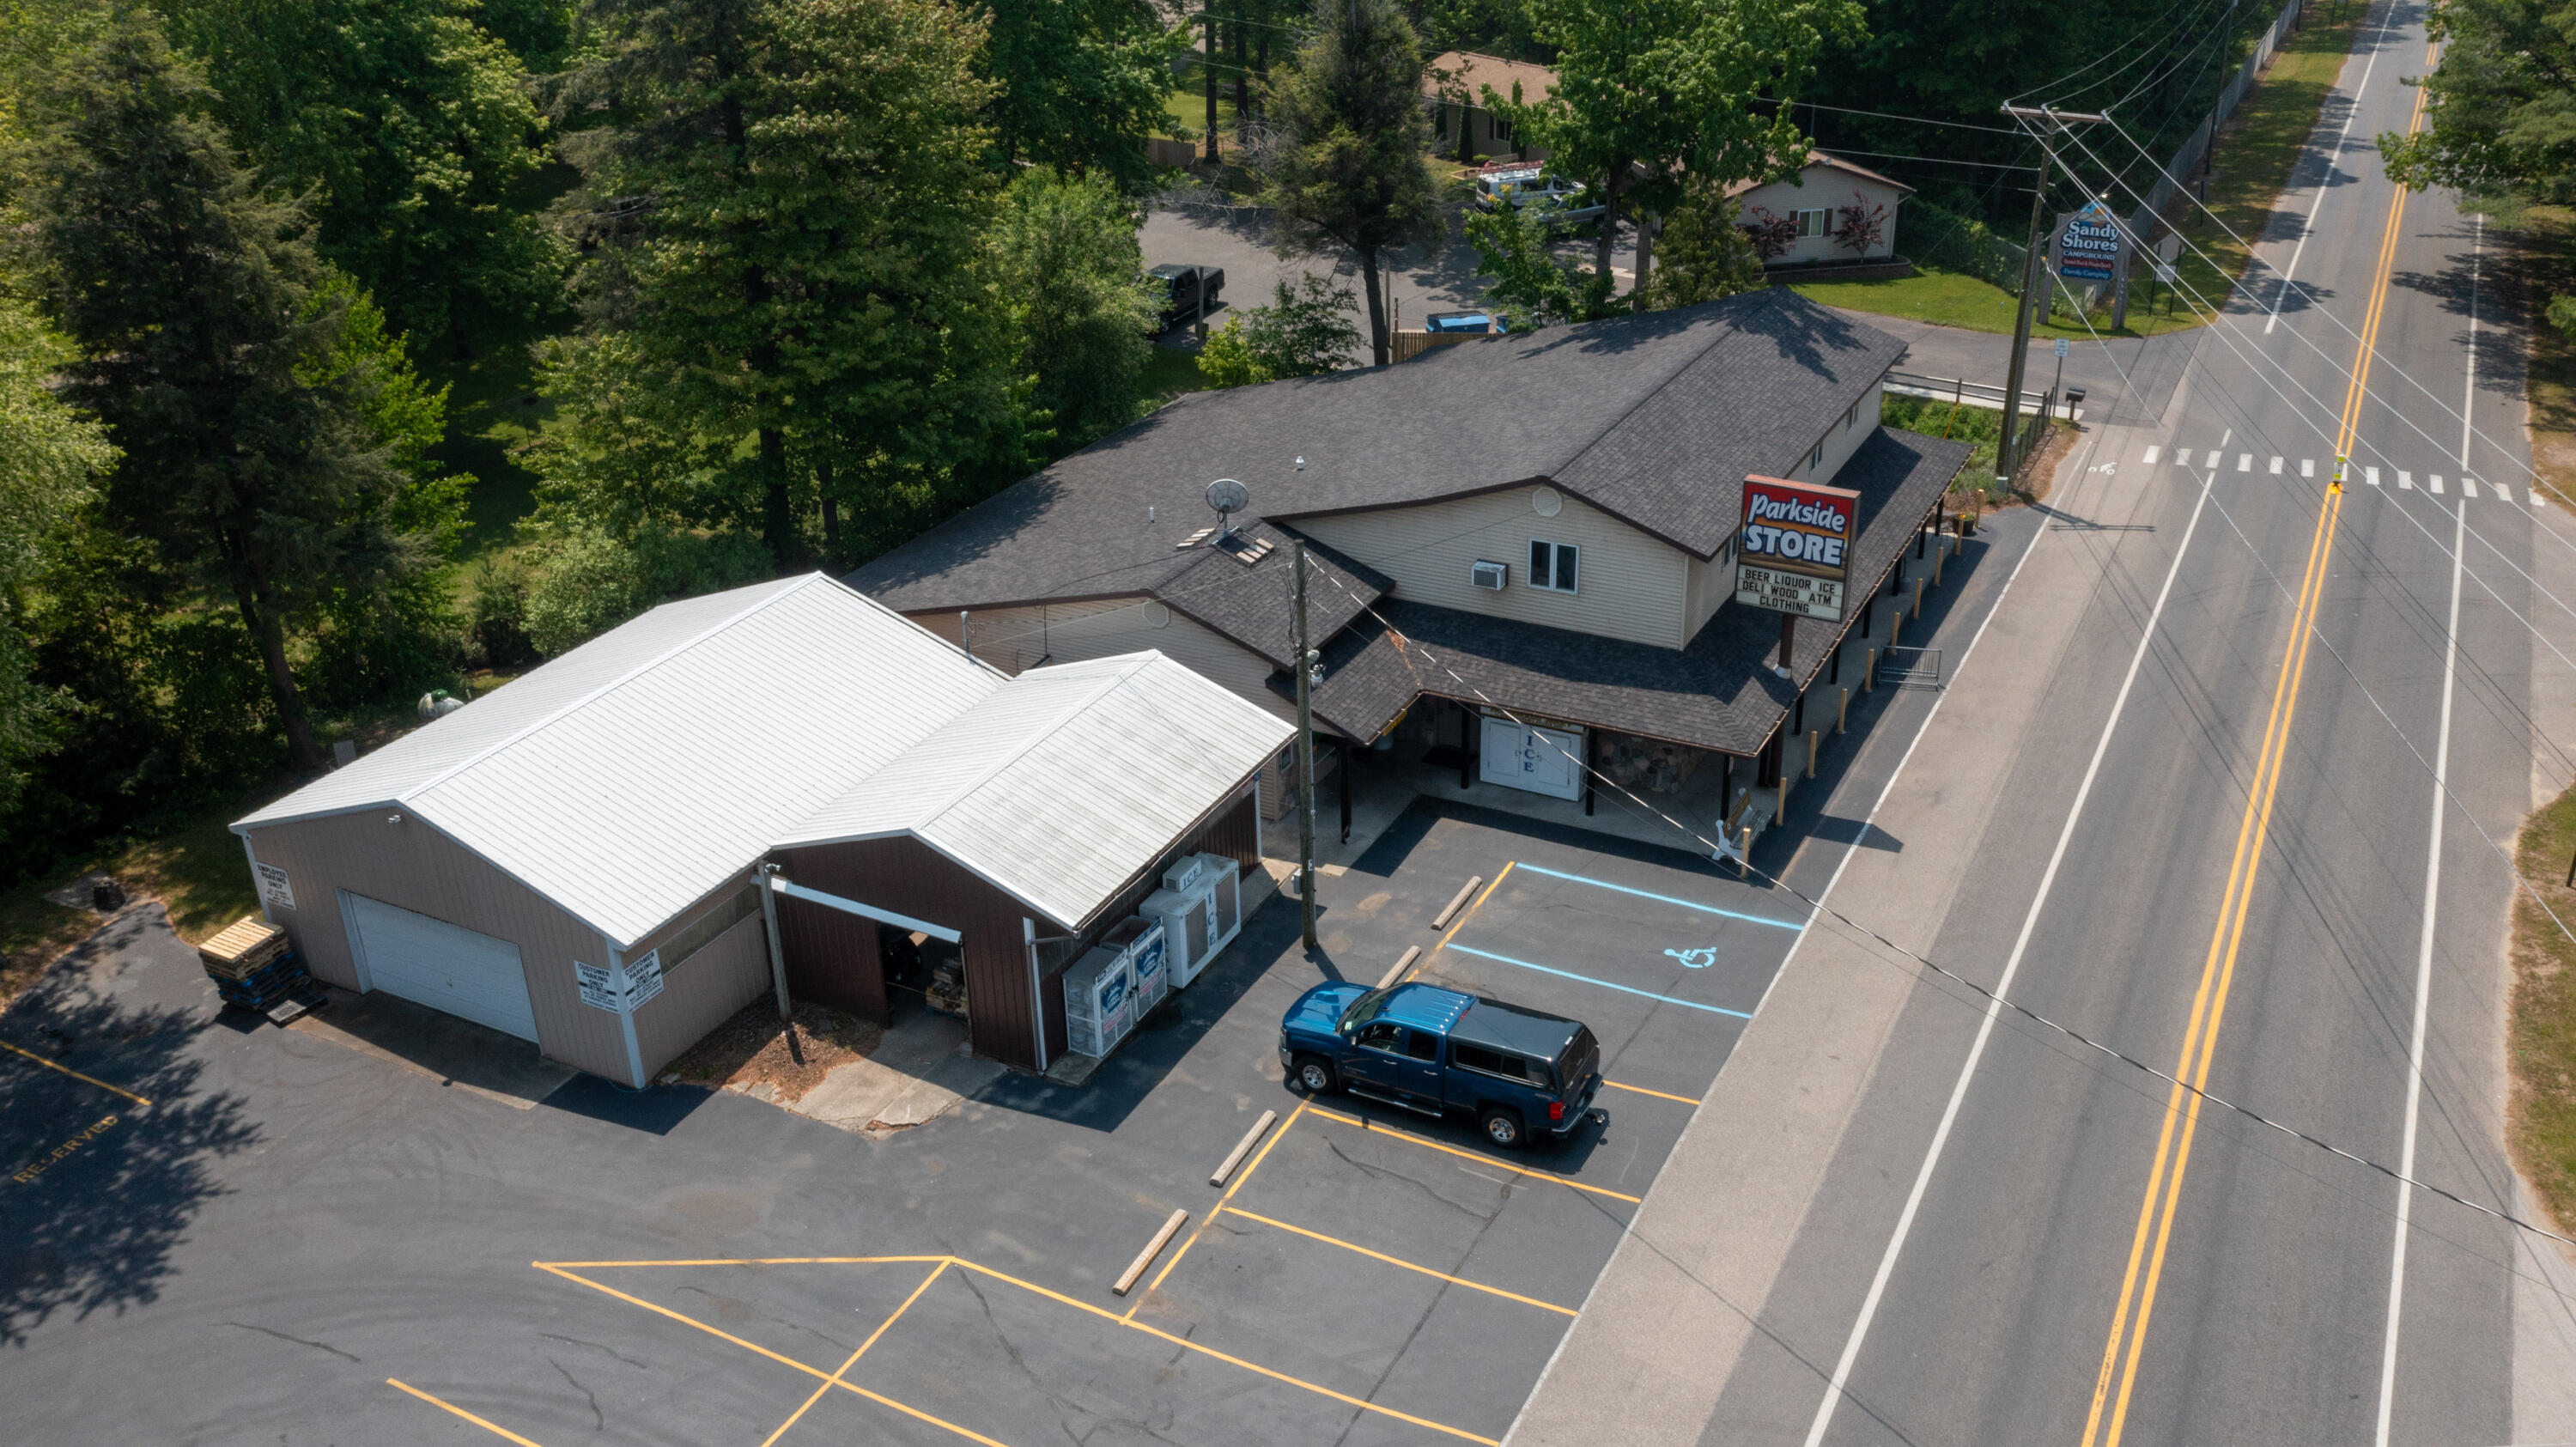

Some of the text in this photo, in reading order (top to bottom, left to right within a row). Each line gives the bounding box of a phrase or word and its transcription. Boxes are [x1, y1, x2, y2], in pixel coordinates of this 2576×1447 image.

[2069, 221, 2120, 240] Sandy
[2062, 234, 2118, 252] Shores
[2063, 250, 2116, 261] CAMPGROUND
[1747, 494, 1845, 532] Parkside
[1746, 525, 1844, 566] STORE
[1745, 569, 1835, 593] BEER LIQUOR ICE
[1742, 581, 1832, 605] DELI WOOD ATM
[1759, 595, 1809, 614] CLOTHING
[1523, 735, 1535, 772] ICE
[1182, 867, 1199, 887] ICE
[1206, 891, 1216, 946] ICE
[578, 963, 611, 977] CUSTOMER
[624, 951, 655, 976] CUSTOMER
[629, 960, 654, 981] PARKING
[582, 970, 609, 983] PARKING
[588, 979, 604, 988] ONLY
[635, 970, 650, 984] ONLY
